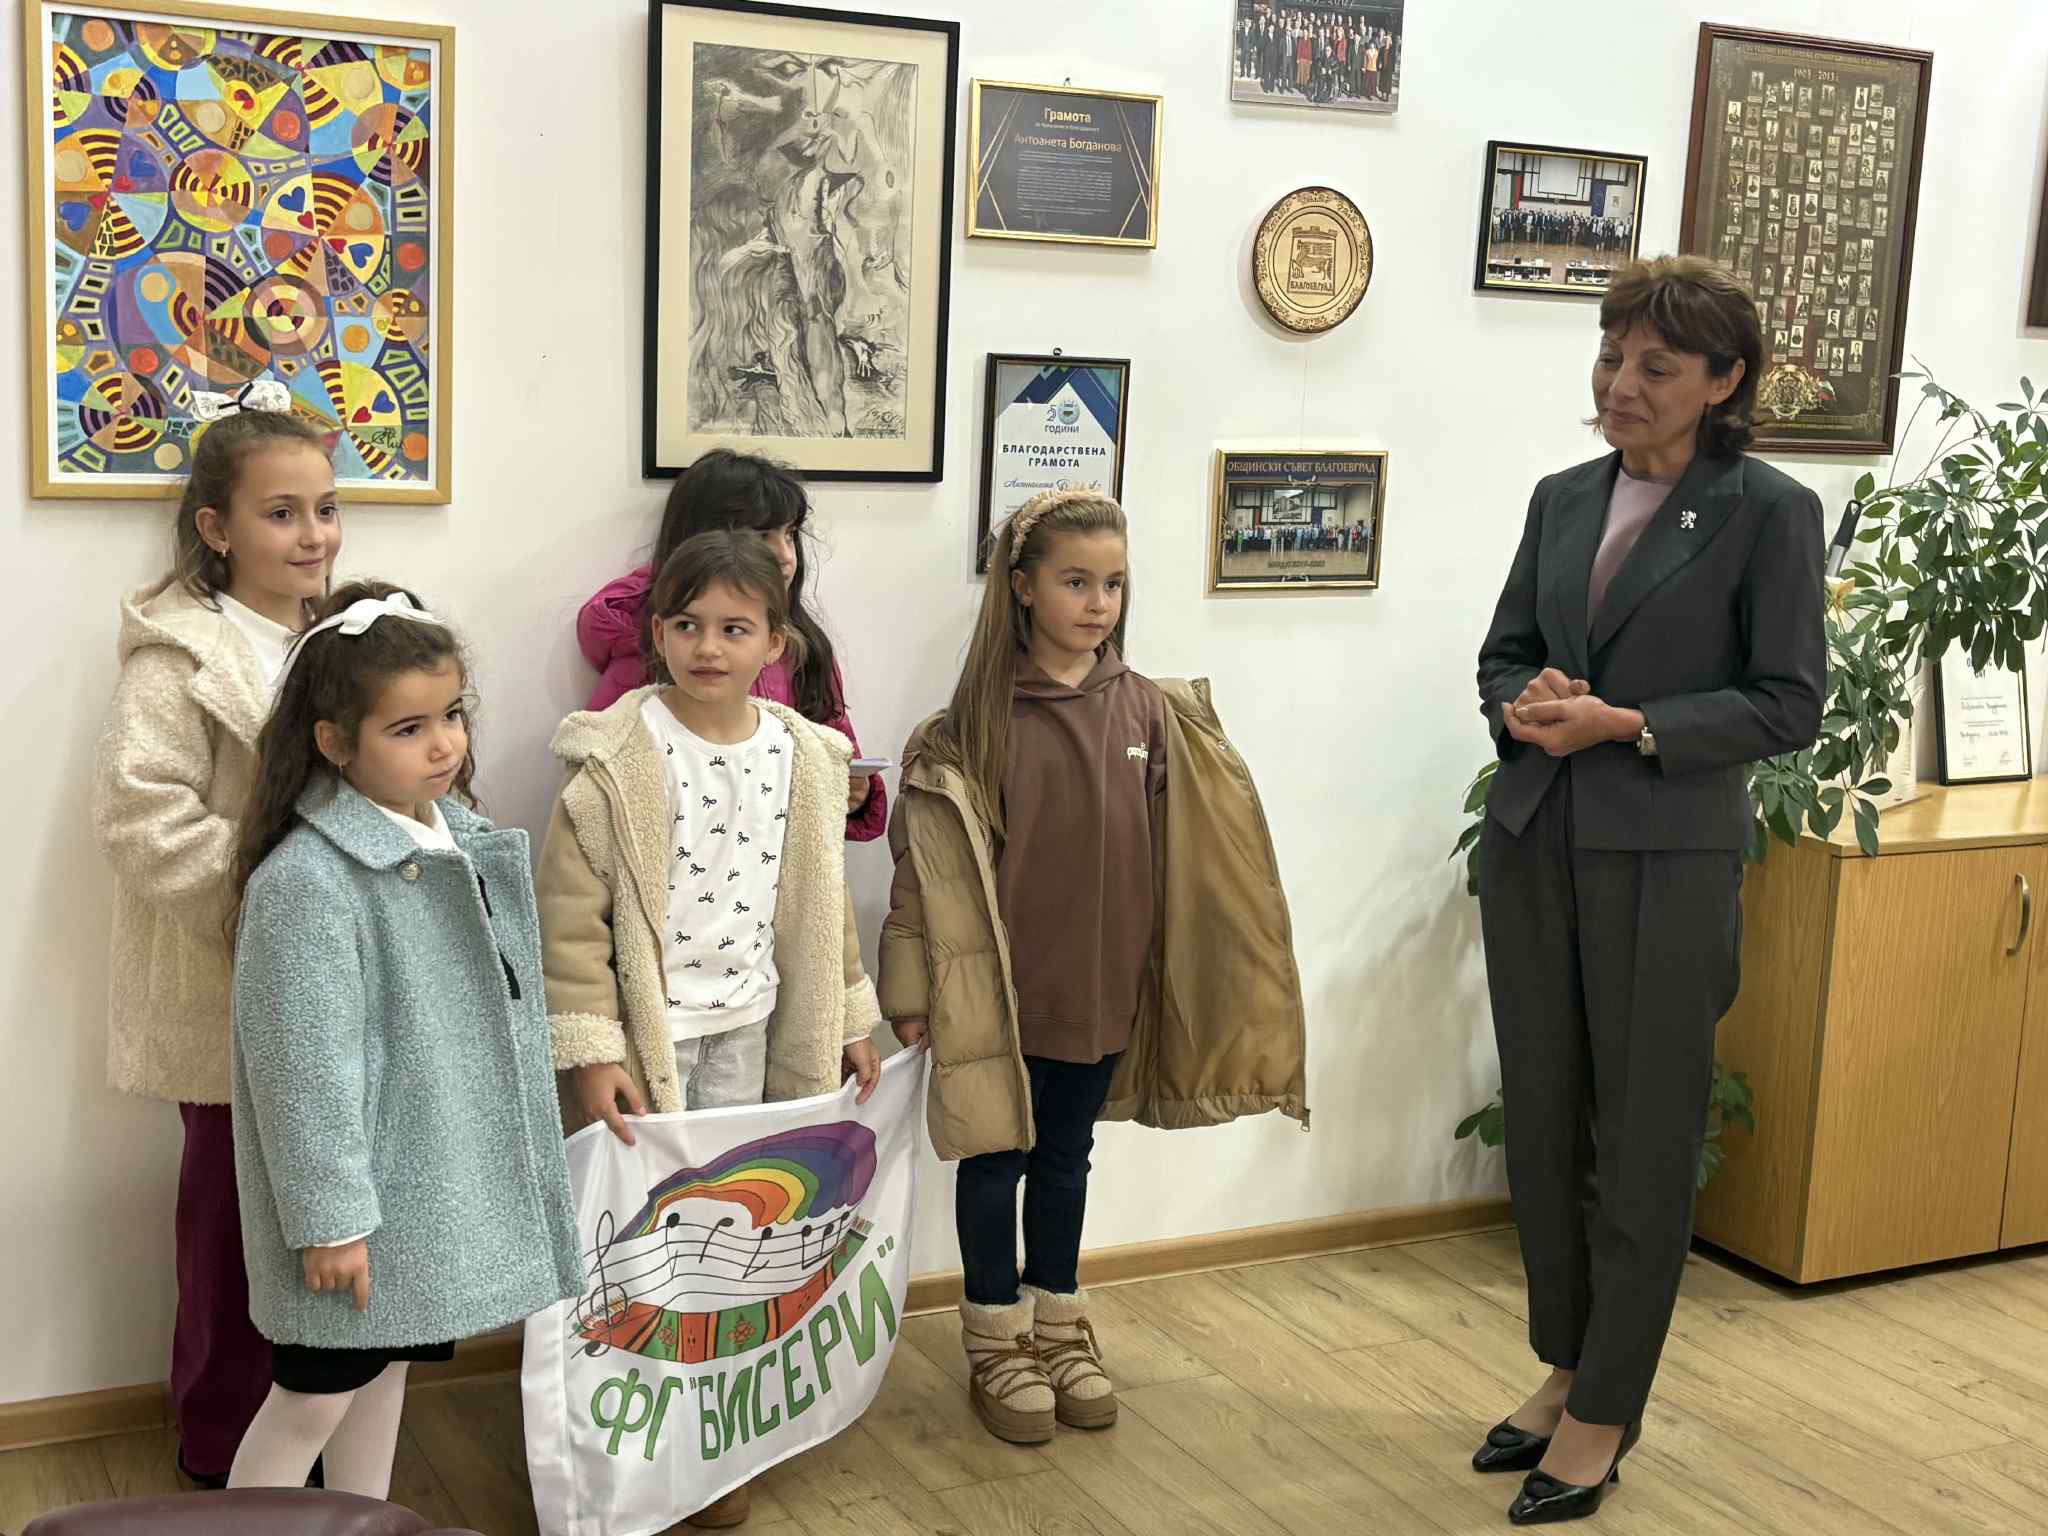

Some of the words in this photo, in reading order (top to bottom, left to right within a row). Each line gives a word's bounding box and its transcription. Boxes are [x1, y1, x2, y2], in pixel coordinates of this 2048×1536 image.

[1044, 107, 1091, 123] Грамота
[1014, 132, 1067, 148] Антоанета
[1069, 138, 1122, 153] Богданова
[1045, 424, 1080, 434] ГОДИНИ
[1003, 444, 1106, 455] БЛАГОДАРСТВЕНА
[1029, 457, 1080, 467] ГРАМОТА
[1227, 461, 1282, 474] ОБЩИНСКИ
[1283, 462, 1314, 473] СЪВЕТ
[1315, 462, 1377, 474] БЛАГОЕВГРАД
[591, 1368, 683, 1461] ФГ
